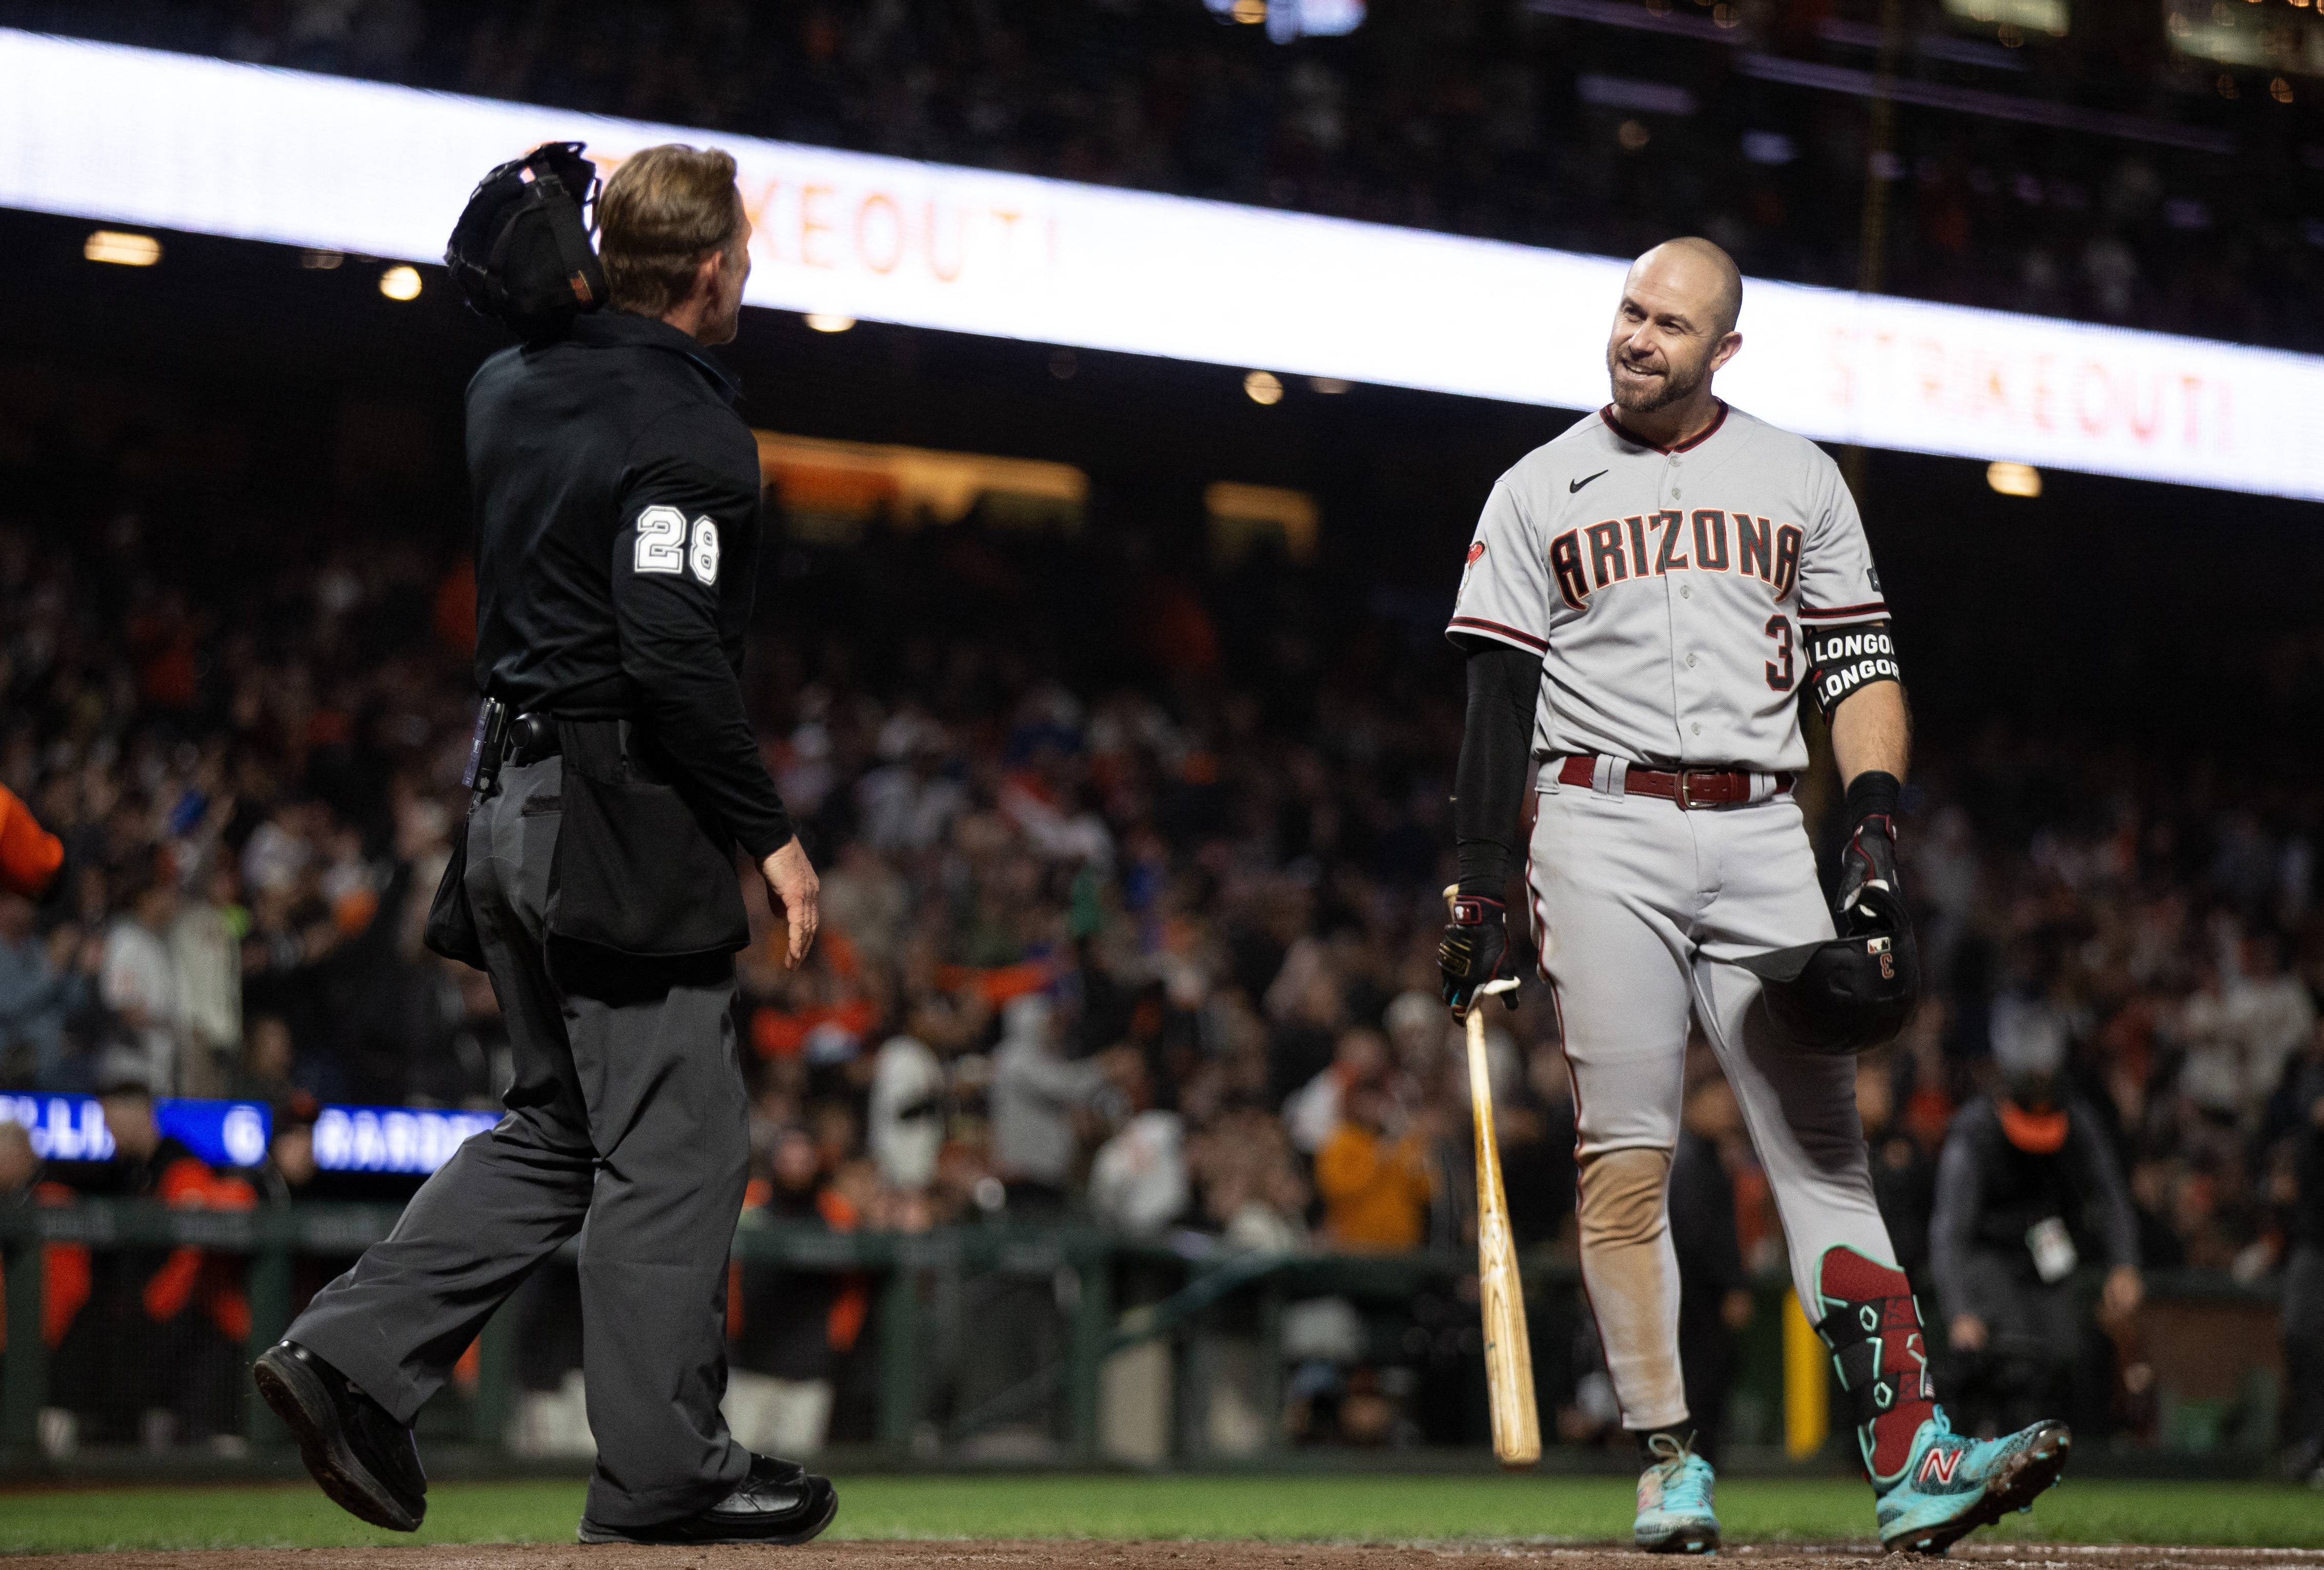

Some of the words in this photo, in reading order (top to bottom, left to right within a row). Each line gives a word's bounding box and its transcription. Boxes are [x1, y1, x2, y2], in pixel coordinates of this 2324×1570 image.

[1823, 323, 2233, 454] STRIKEOUT!
[634, 504, 719, 586] 28
[1549, 508, 1804, 611] ARIZONA
[1765, 615, 1794, 691] 3
